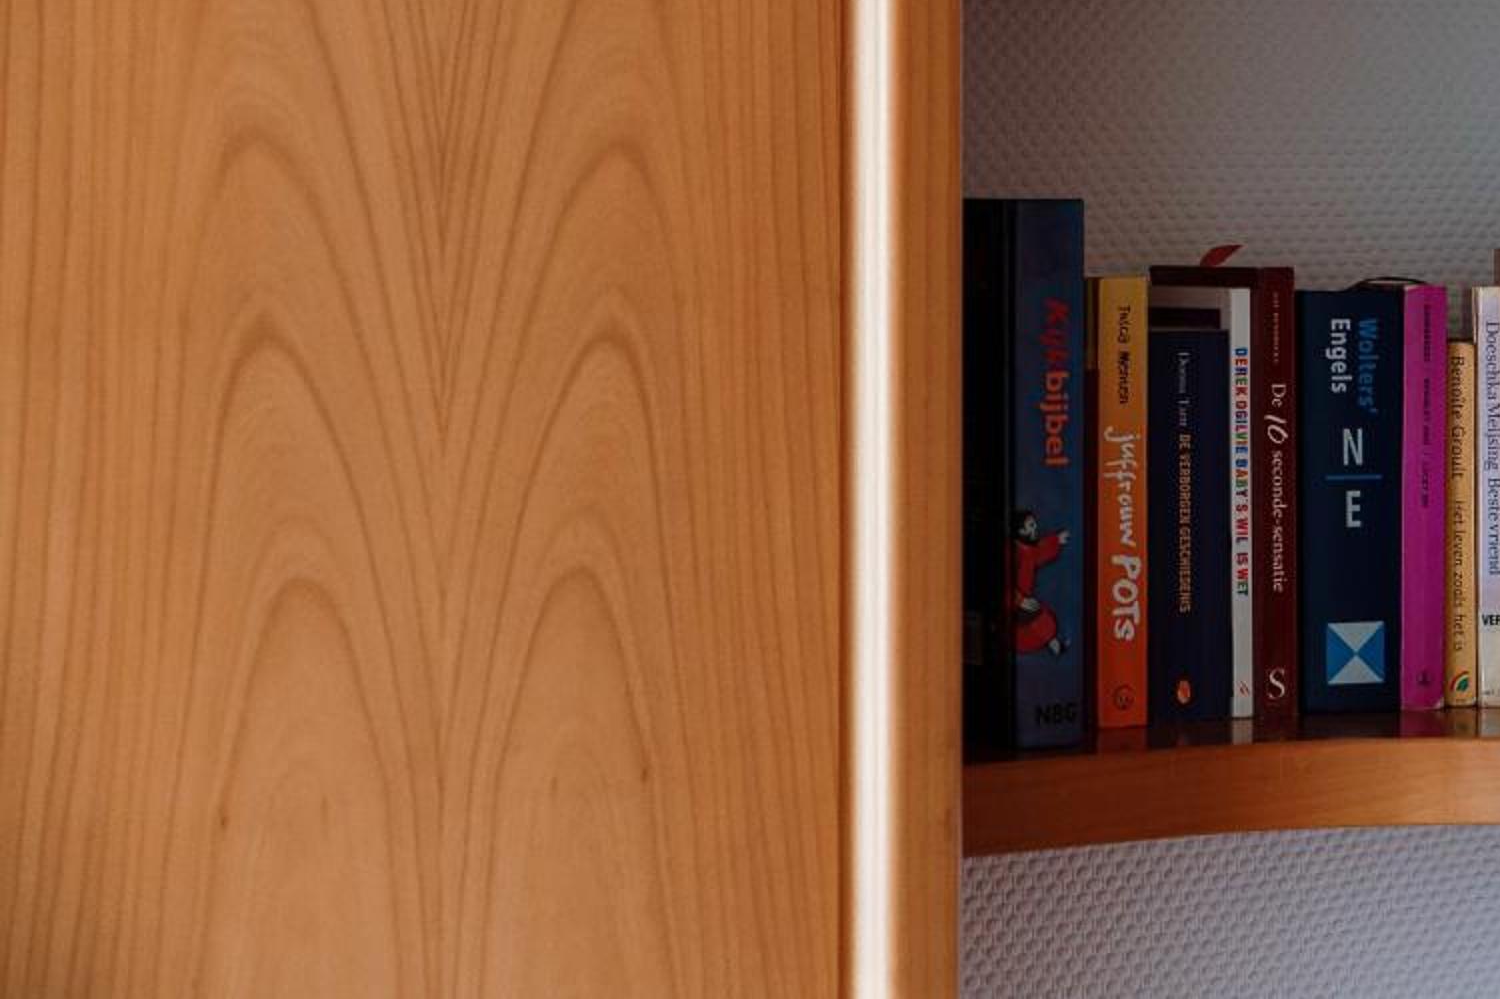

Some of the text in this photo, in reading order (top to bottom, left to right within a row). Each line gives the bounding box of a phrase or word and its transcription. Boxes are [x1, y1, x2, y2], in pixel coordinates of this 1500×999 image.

[1118, 305, 1132, 405] Tosca Menten
[1235, 348, 1249, 396] DEREK
[1326, 318, 1352, 394] Engels
[1356, 318, 1378, 415] Wolters'
[1484, 321, 1500, 400] Doeschka
[1271, 383, 1287, 408] De
[1451, 355, 1467, 419] Benoîte
[1179, 434, 1191, 449] DE
[1235, 400, 1249, 454] OGILVIE
[1264, 414, 1289, 445] 10
[1342, 428, 1364, 466] N
[1482, 403, 1500, 471] Meijsing
[1451, 425, 1466, 479] Groult
[1104, 428, 1142, 549] juffrouw
[1179, 453, 1191, 524] VERBORGEN
[1344, 489, 1362, 529] E
[1235, 517, 1249, 544] WIL
[1271, 449, 1287, 593] seconde-sensatie
[1179, 527, 1191, 613] GESCHIEDENIS
[1235, 552, 1248, 567] IS
[1453, 529, 1466, 566] leven
[1235, 568, 1248, 597] WET
[1453, 570, 1466, 608] zoals
[1453, 613, 1466, 636] het
[1453, 641, 1464, 652] is
